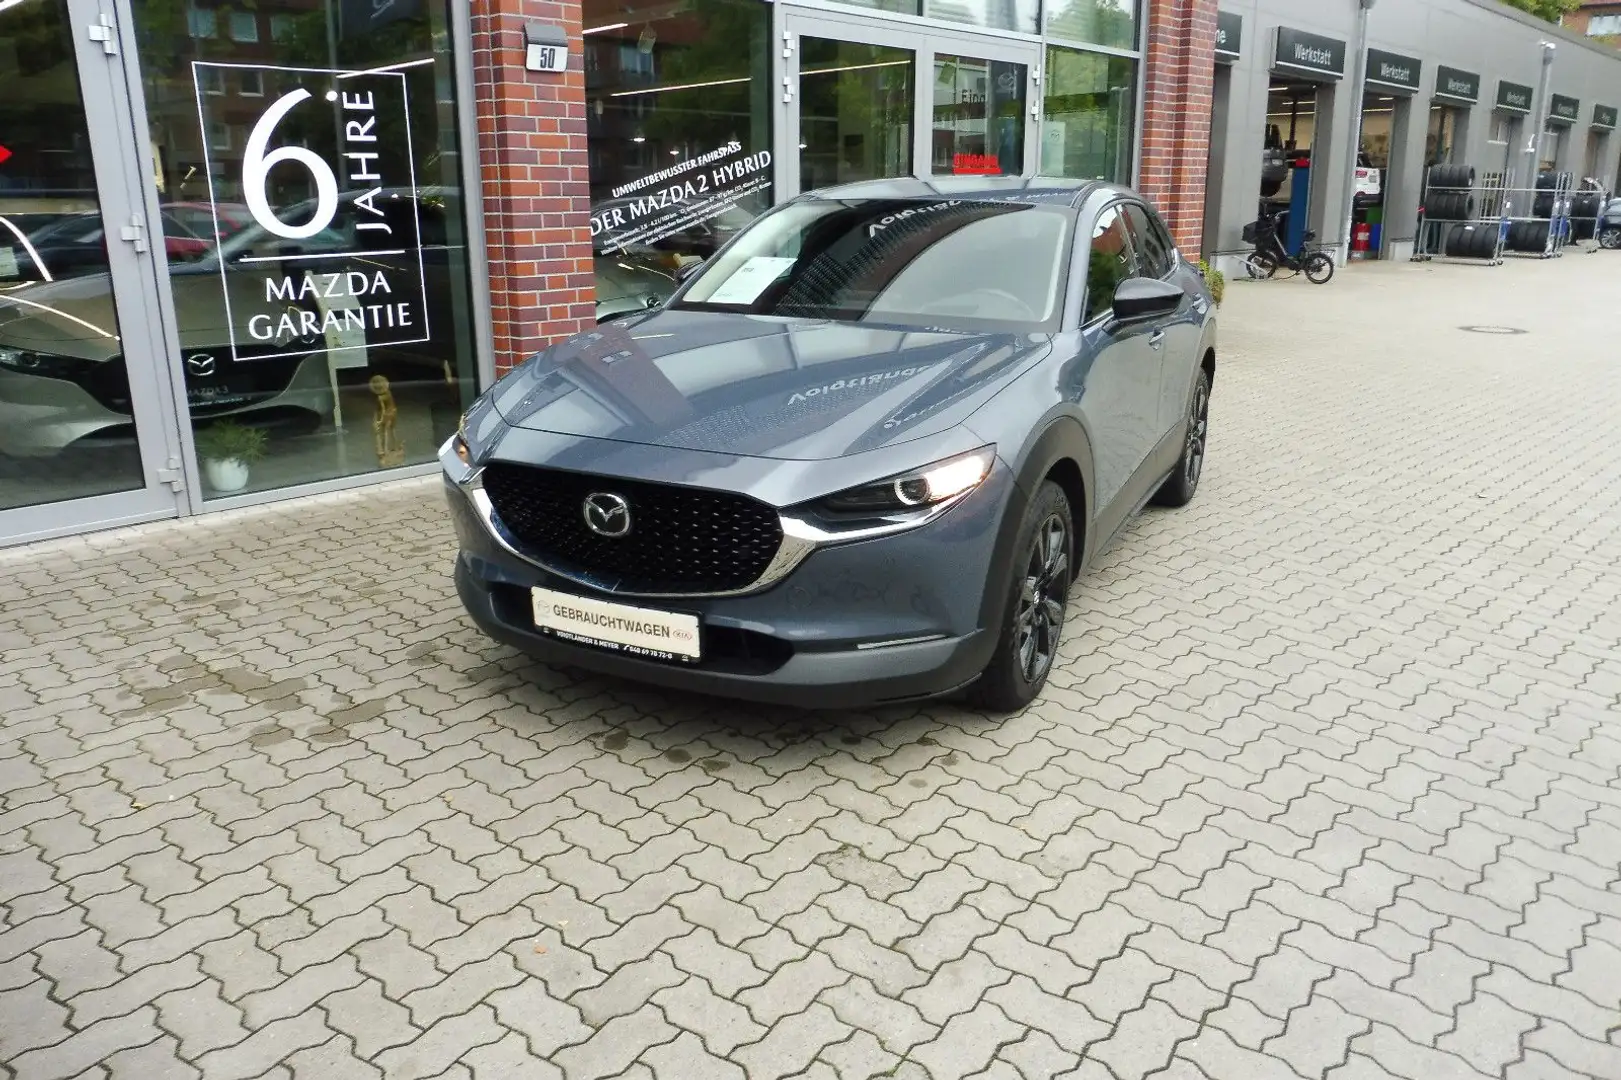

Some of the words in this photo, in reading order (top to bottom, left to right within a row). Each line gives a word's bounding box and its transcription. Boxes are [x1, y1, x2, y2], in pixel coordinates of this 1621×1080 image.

[540, 47, 556, 69] 50
[1294, 43, 1332, 66] Werkstatt
[1380, 62, 1410, 82] Werkstatt
[242, 87, 338, 239] 6
[342, 90, 392, 234] JAHRE
[611, 159, 697, 198] UMWELTBEWUSSTER
[697, 141, 742, 166] FAHRSPASS
[590, 207, 627, 237] DER
[629, 180, 696, 220] MAZDA
[697, 174, 709, 194] 2
[713, 150, 772, 187] HYBRID
[266, 271, 391, 302] MAZDA
[248, 303, 412, 340] GARANTIE
[553, 604, 670, 638] GEBRAUCHTWAGEN
[599, 640, 619, 650] MEYER
